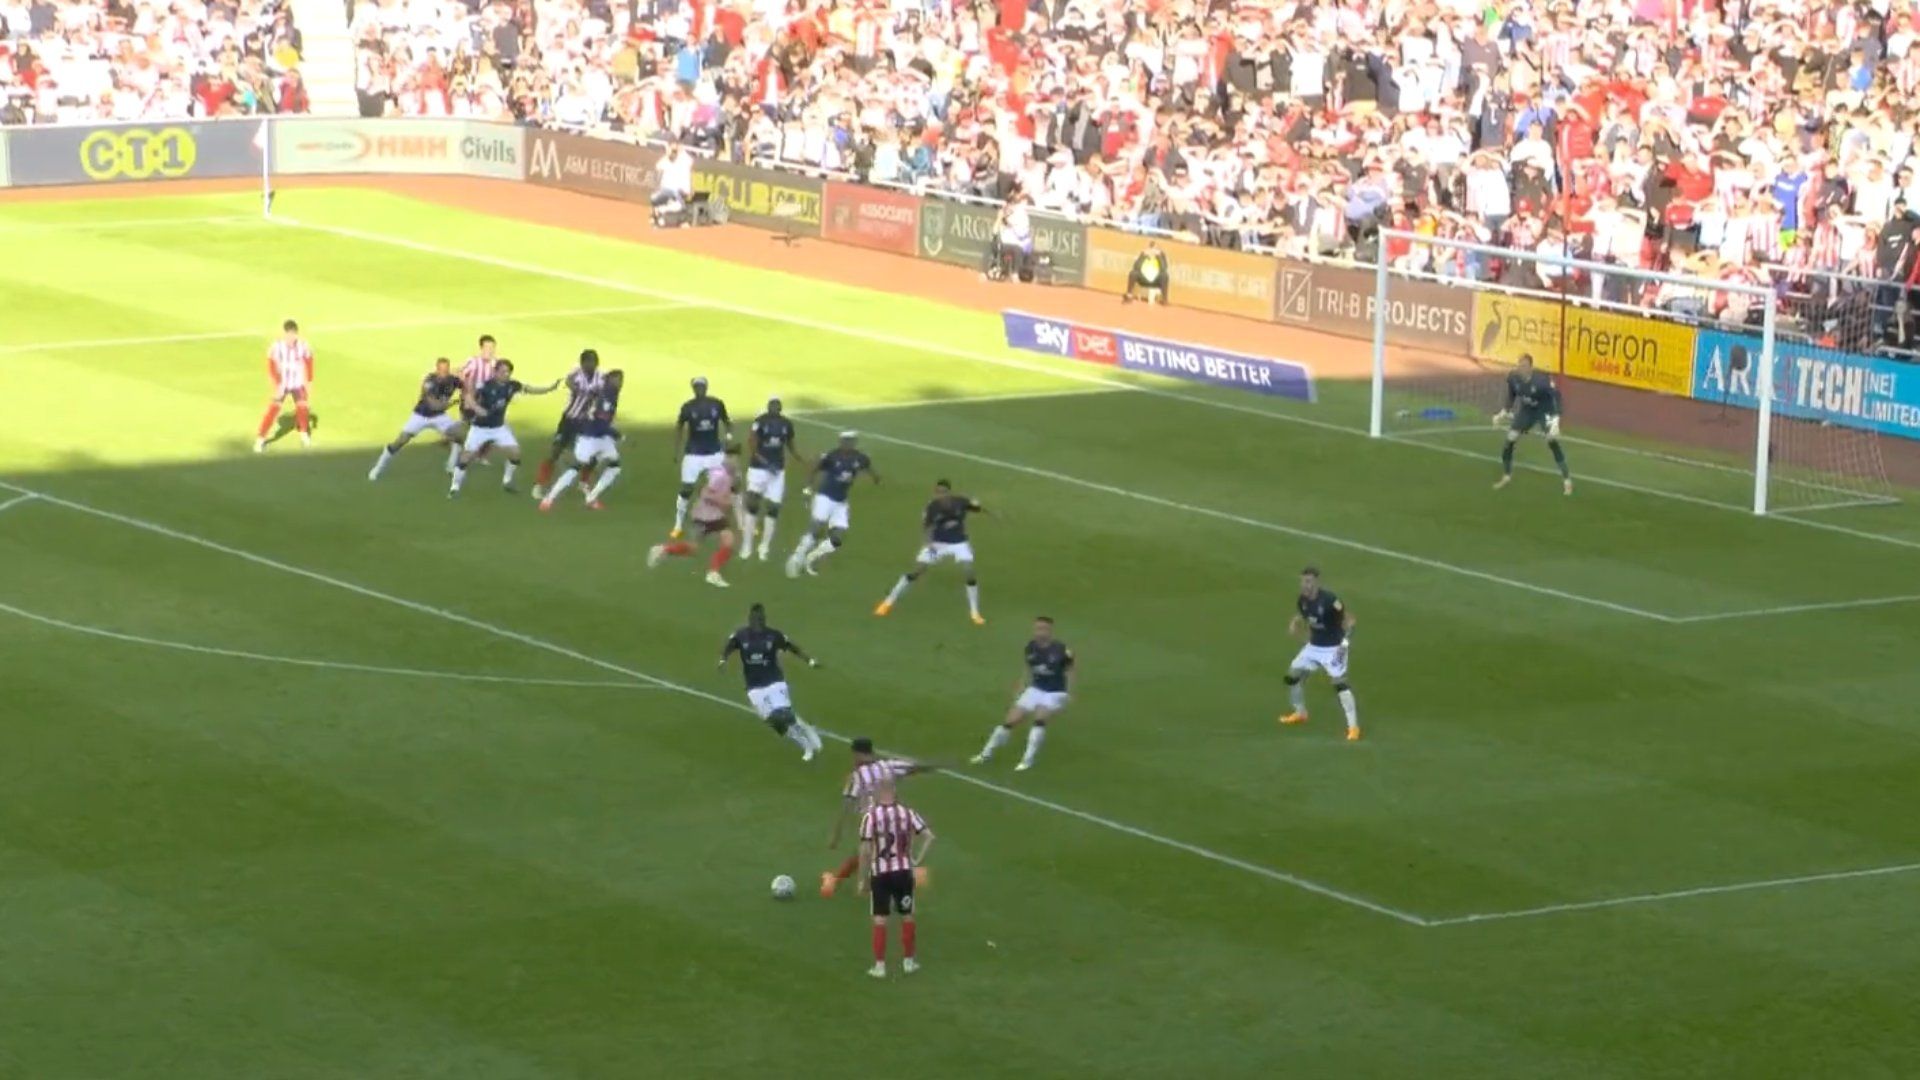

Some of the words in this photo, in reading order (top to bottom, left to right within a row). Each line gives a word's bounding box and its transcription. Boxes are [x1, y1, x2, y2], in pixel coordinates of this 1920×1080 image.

[376, 135, 449, 158] HMH
[461, 136, 517, 164] Civils
[1034, 322, 1069, 355] sky
[1123, 341, 1199, 373] BETTING
[1204, 356, 1272, 387] BETTER
[1623, 361, 1632, 377] &
[1796, 357, 1863, 416] TECH
